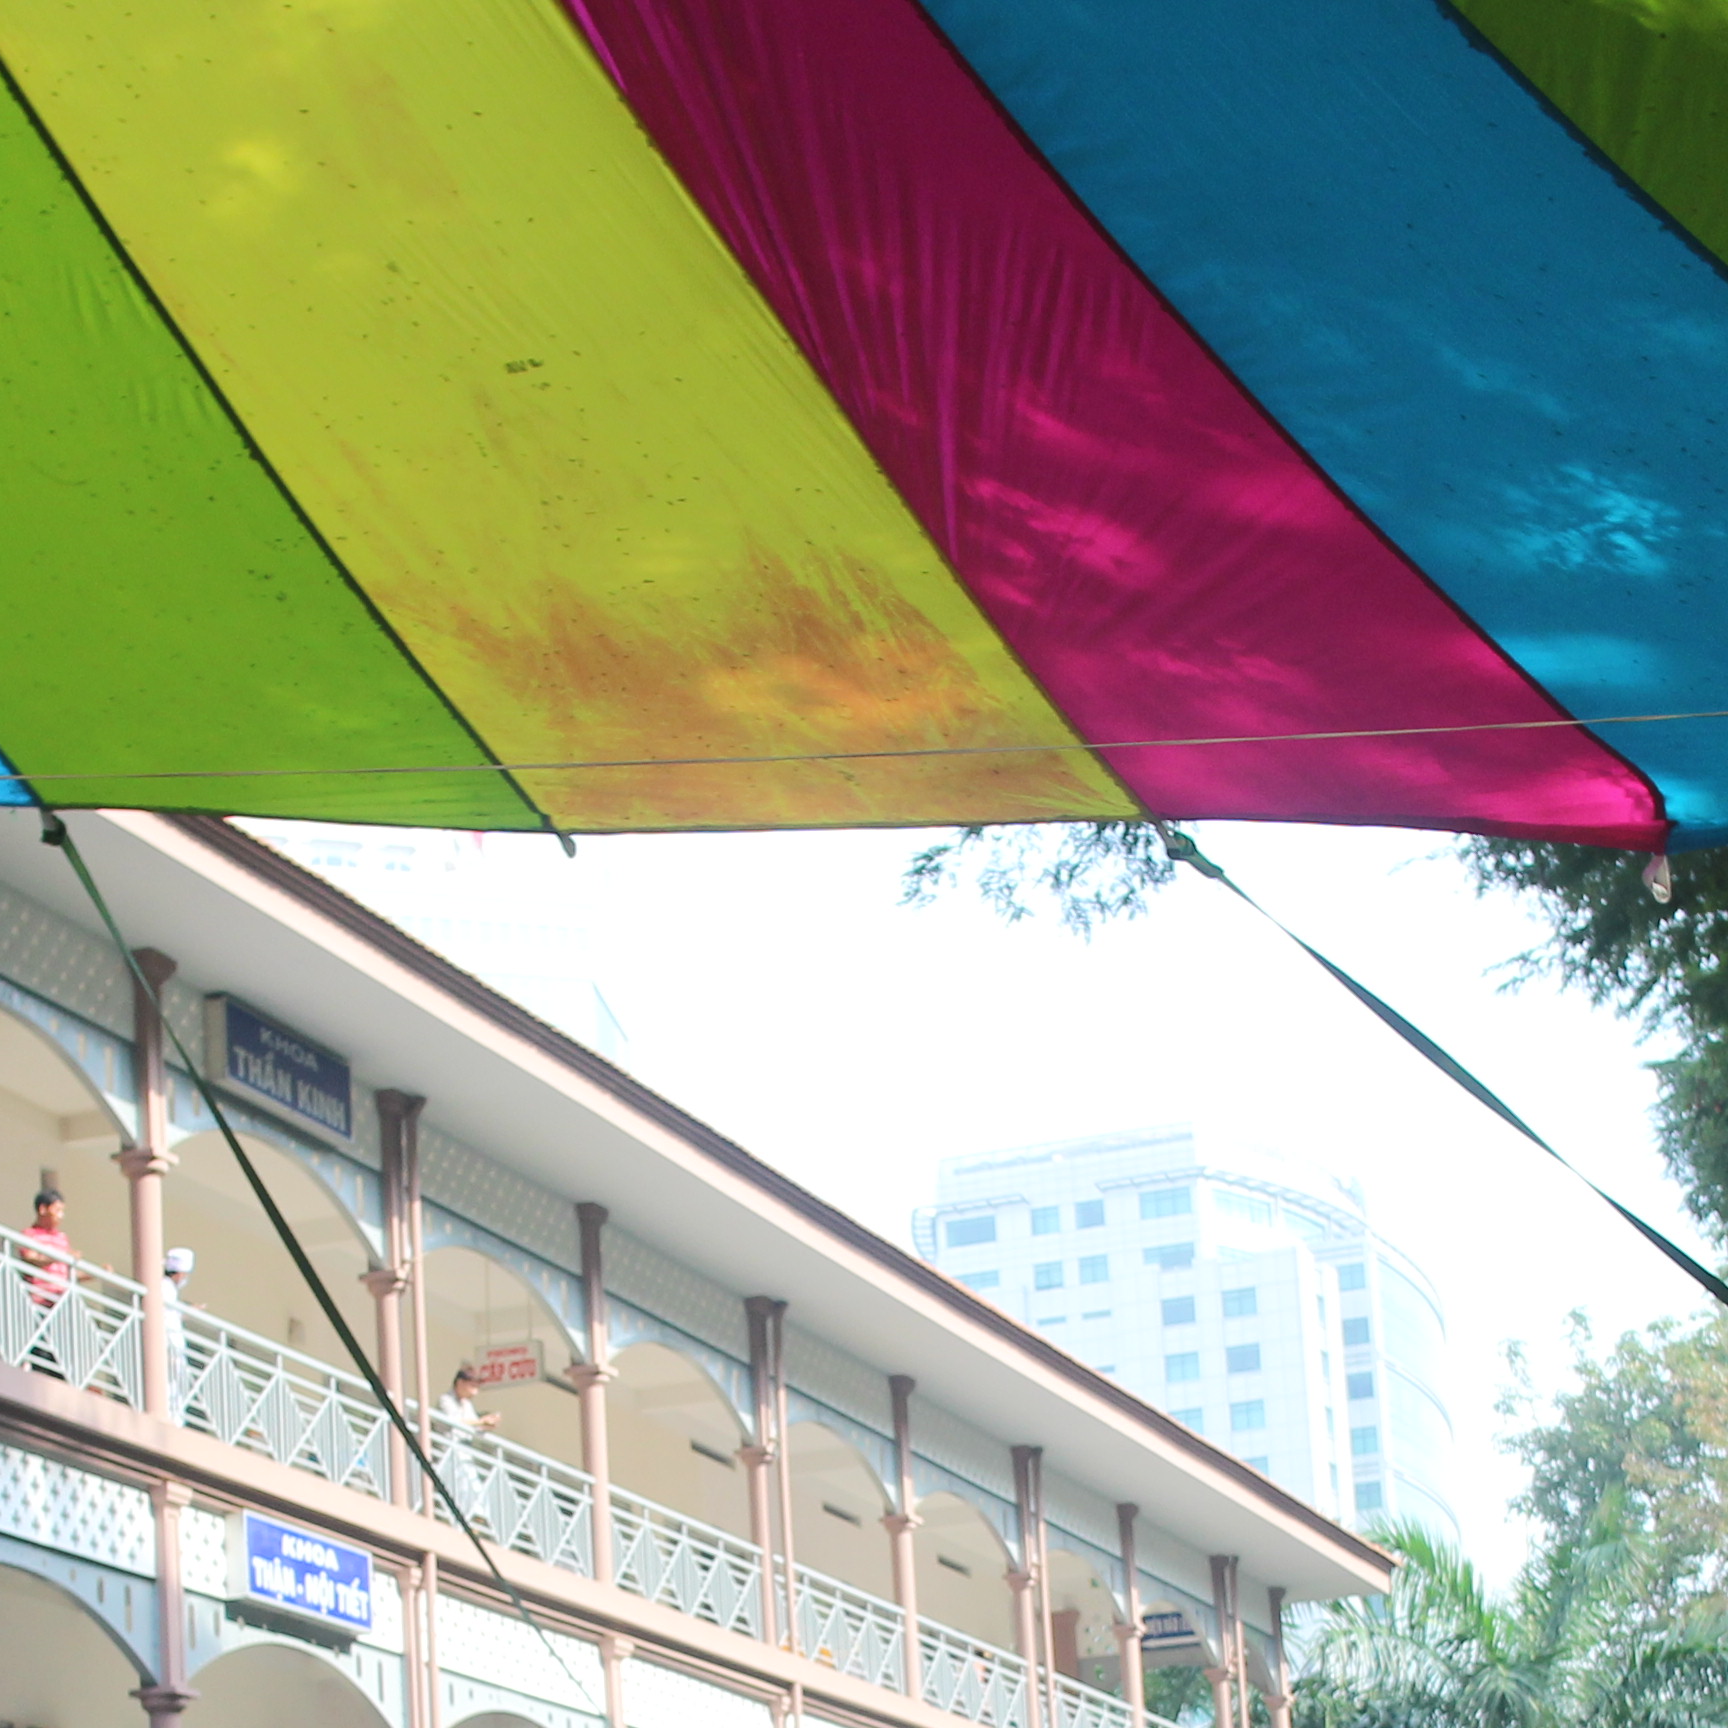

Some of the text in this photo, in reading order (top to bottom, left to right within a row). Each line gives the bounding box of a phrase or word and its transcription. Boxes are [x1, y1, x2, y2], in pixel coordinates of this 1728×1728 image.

[260, 1026, 319, 1073] KHOA
[296, 1079, 346, 1132] KINH
[281, 1533, 339, 1572] KHOA
[252, 1555, 297, 1601] THẬN
[304, 1571, 335, 1615] NỘI
[336, 1577, 369, 1621] TIẾT
